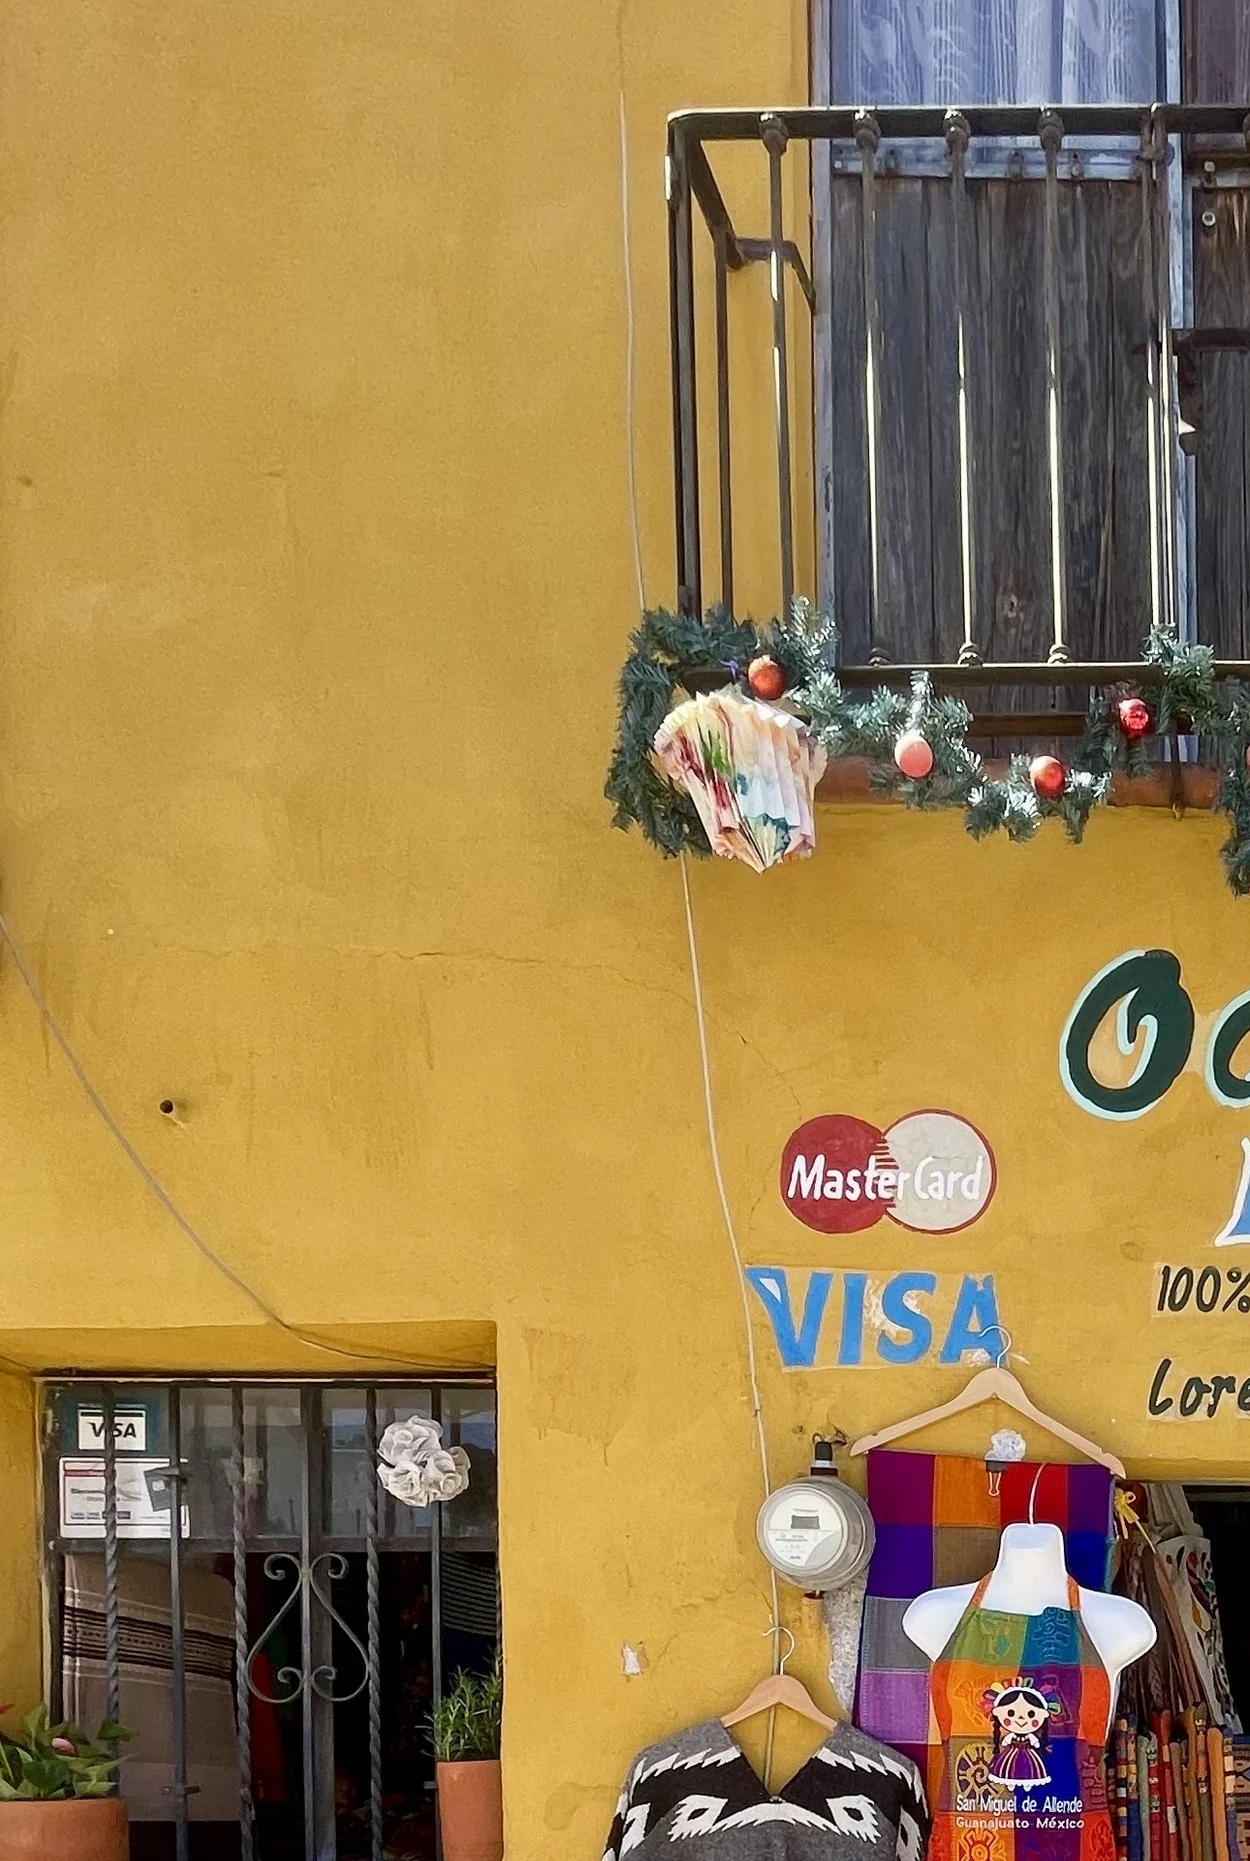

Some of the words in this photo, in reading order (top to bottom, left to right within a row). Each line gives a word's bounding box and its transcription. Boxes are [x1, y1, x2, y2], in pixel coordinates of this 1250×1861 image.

[787, 1155, 985, 1201] MasterCard
[745, 1267, 1007, 1367] VISA
[88, 1421, 137, 1438] VSA
[956, 1795, 976, 1813] San
[981, 1796, 1017, 1816] Miguel
[1021, 1796, 1037, 1813] de
[1042, 1795, 1083, 1813] Allende
[955, 1817, 1030, 1830] Guanajuato
[1036, 1816, 1085, 1830] México
